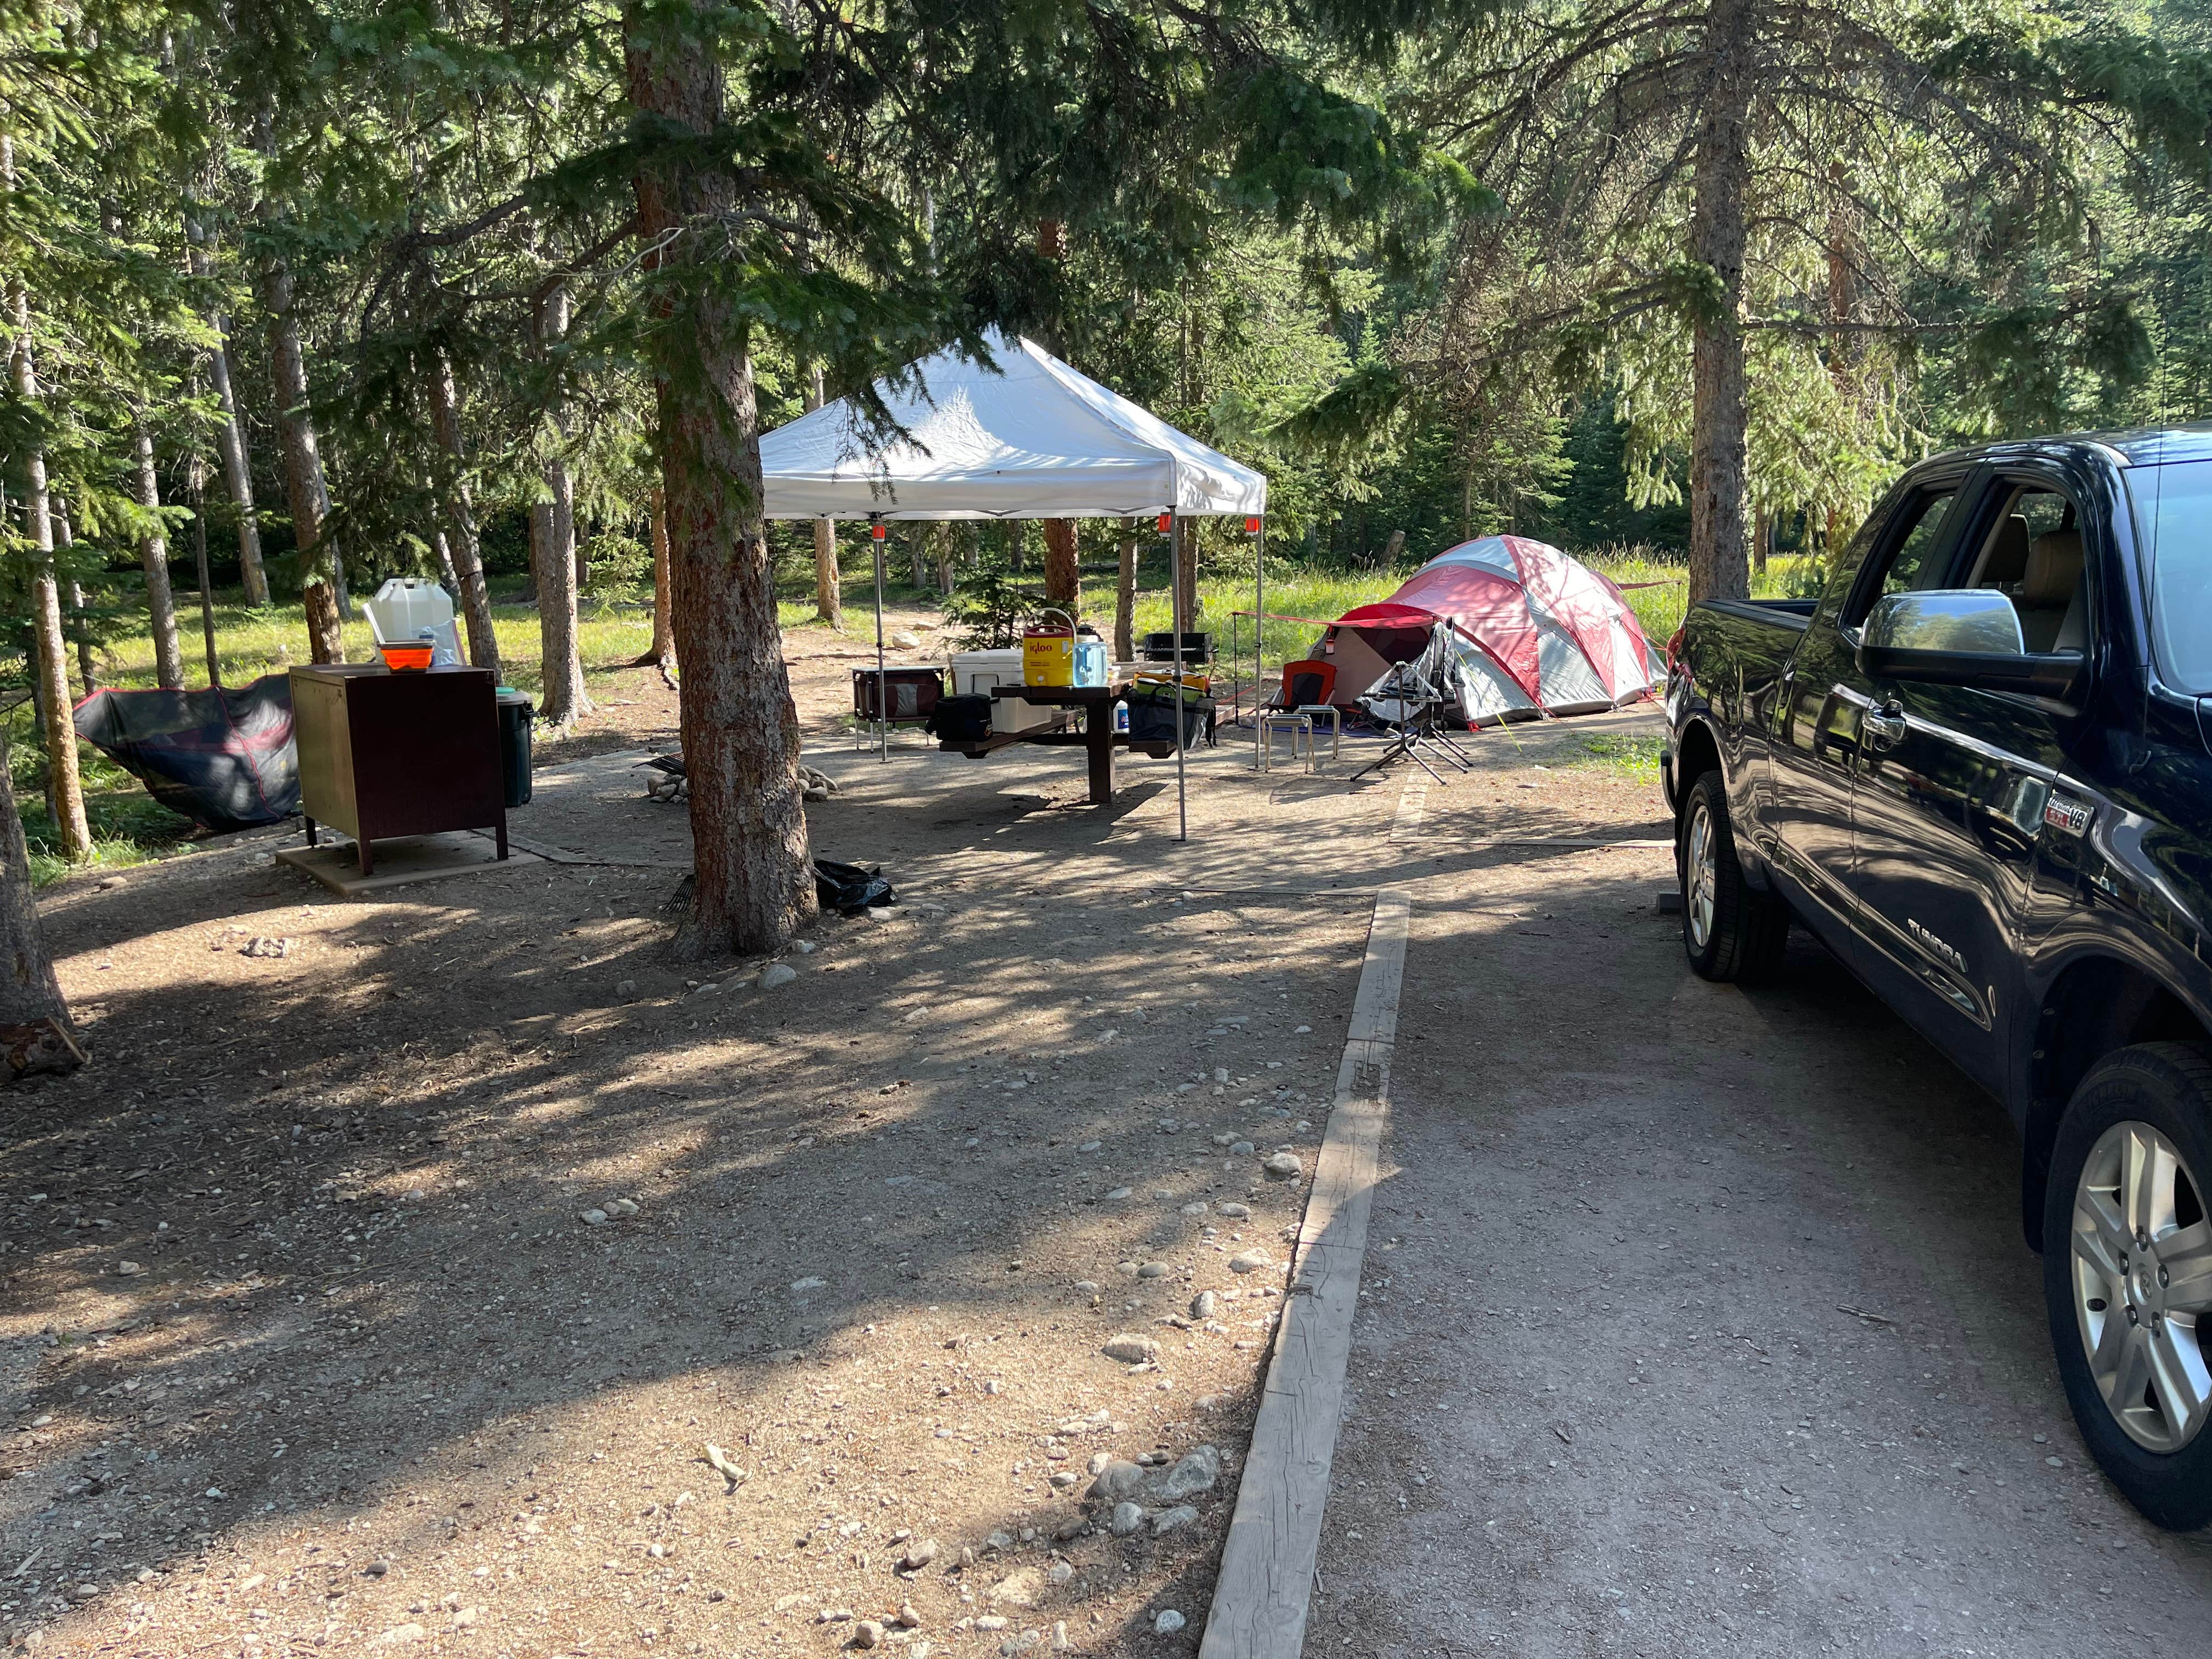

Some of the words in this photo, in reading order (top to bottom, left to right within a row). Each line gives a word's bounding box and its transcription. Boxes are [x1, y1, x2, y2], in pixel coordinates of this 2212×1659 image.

[1029, 641, 1052, 654] igloo
[2069, 808, 2085, 830] V8
[1908, 918, 1968, 973] TUNDRA
